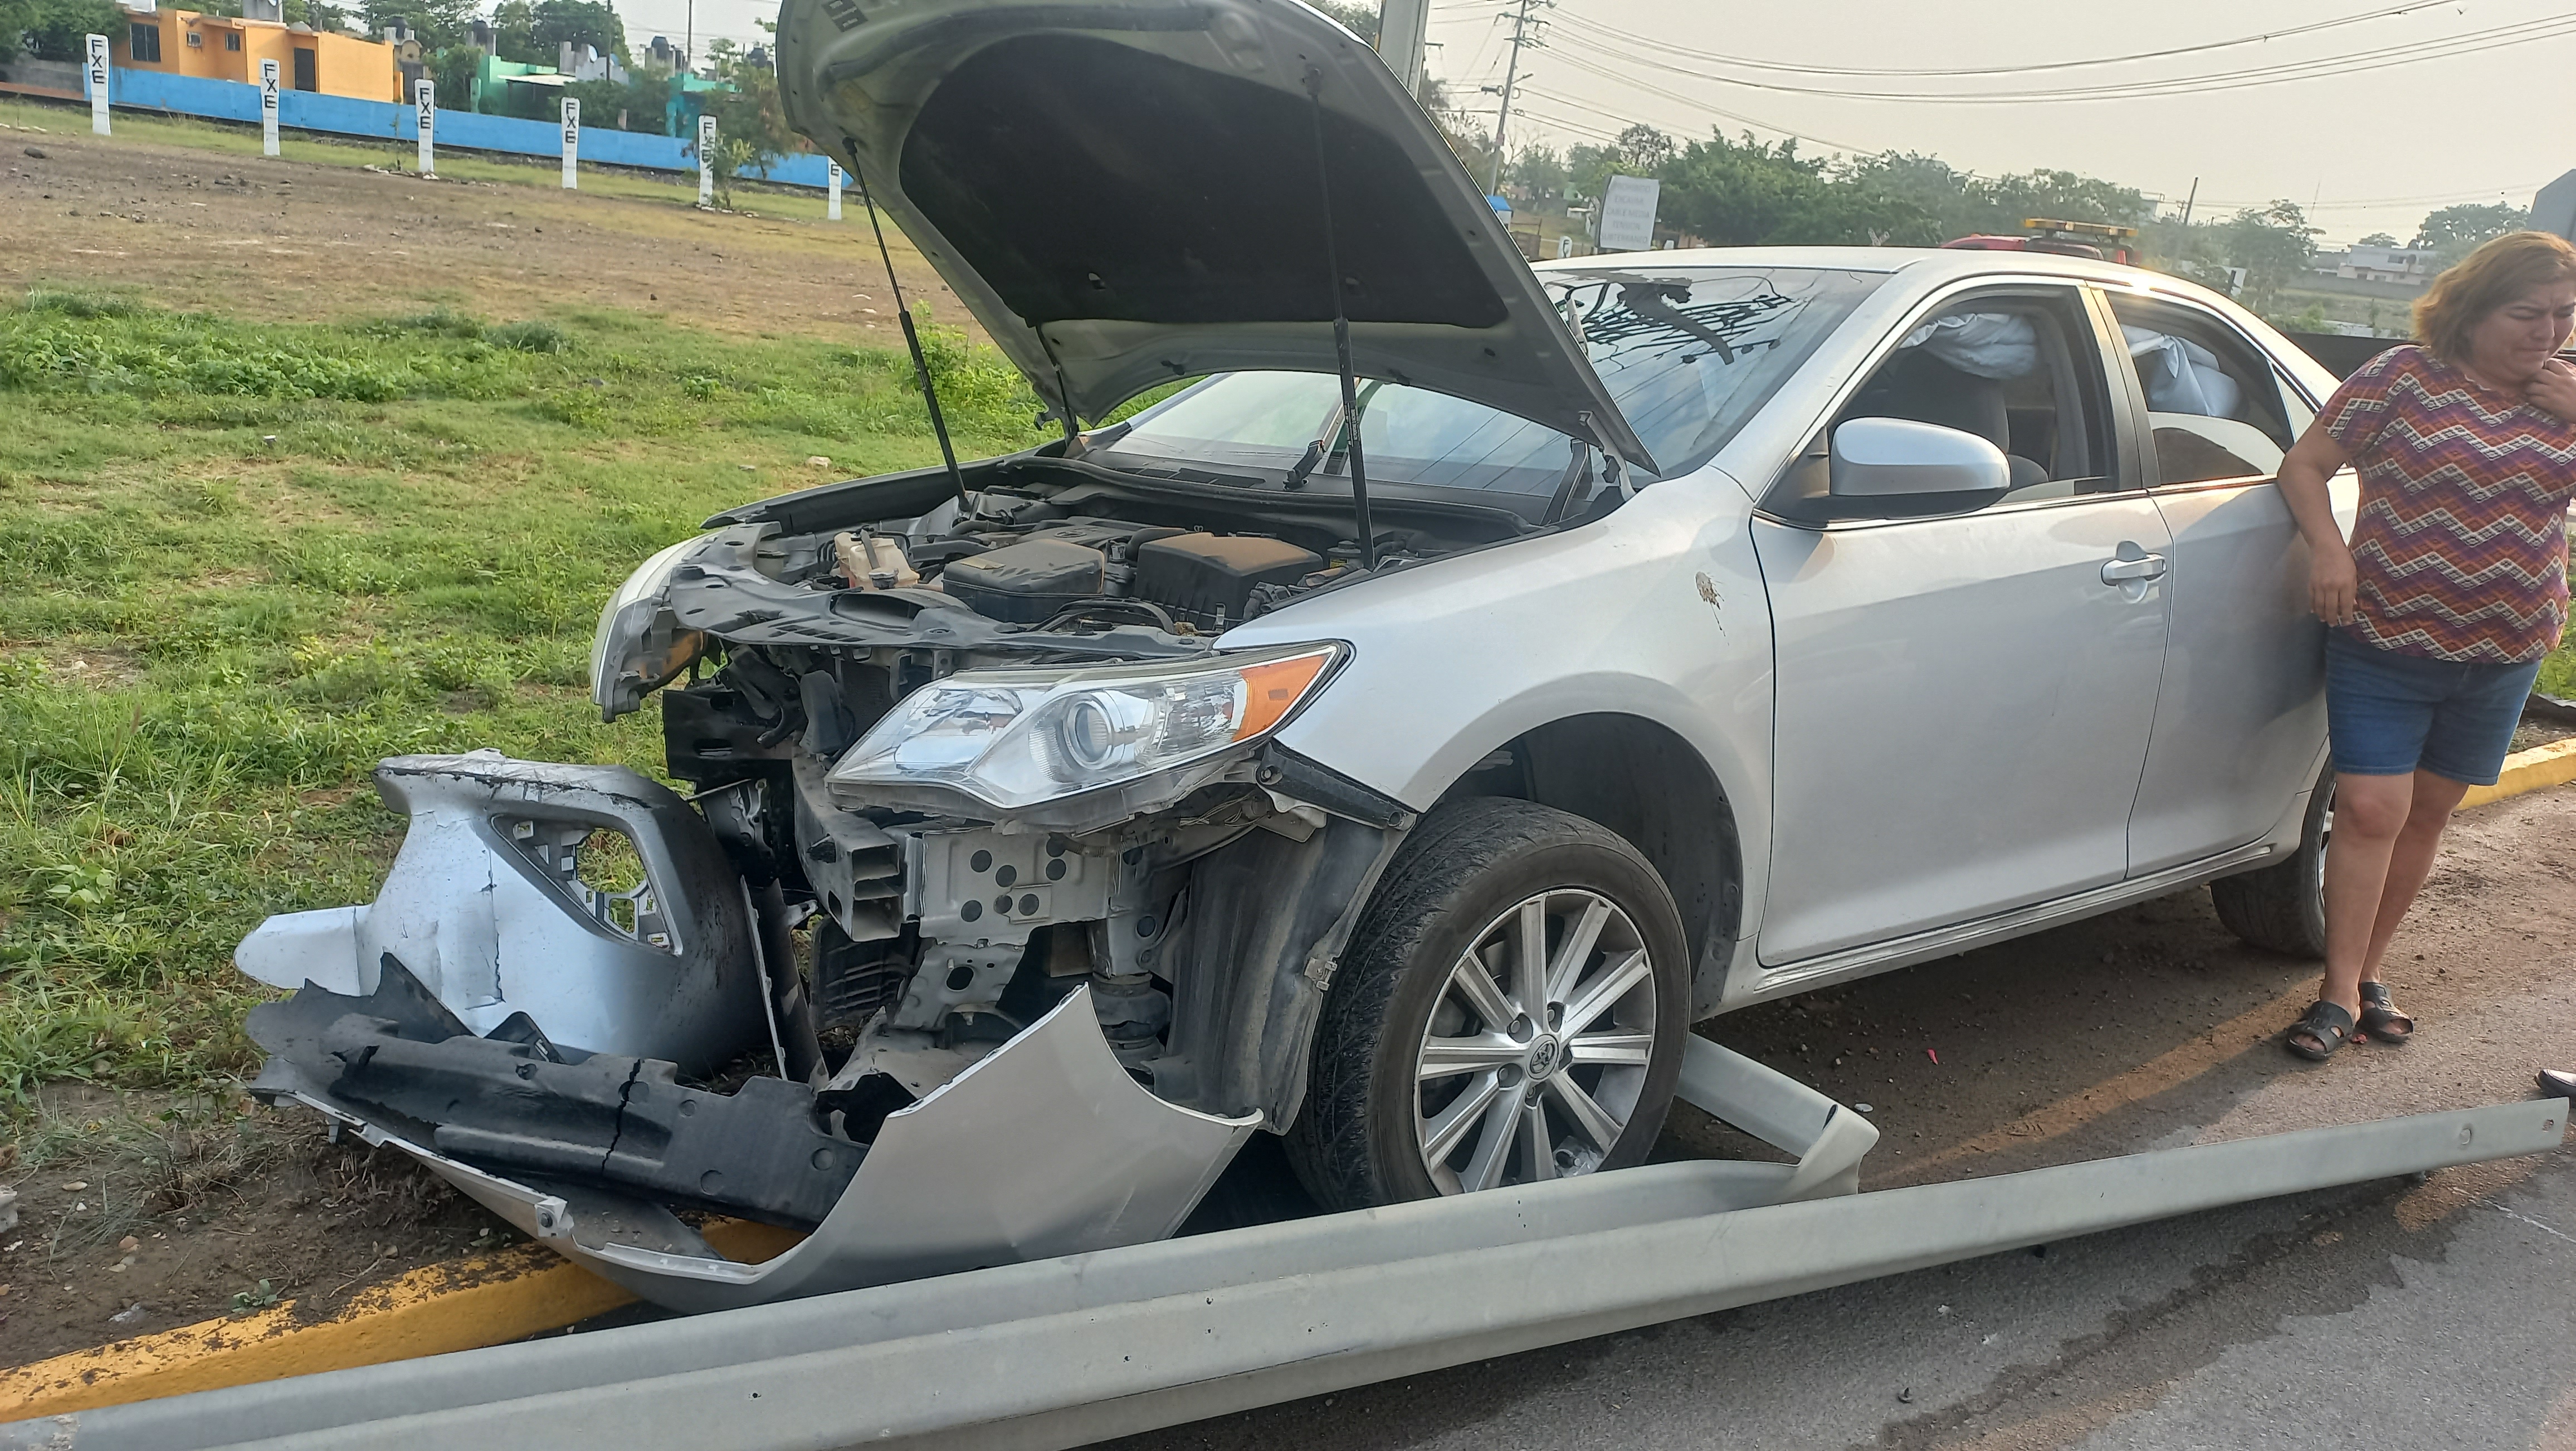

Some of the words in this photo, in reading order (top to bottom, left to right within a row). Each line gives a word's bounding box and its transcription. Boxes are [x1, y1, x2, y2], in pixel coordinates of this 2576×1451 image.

[91, 39, 105, 84] FXE
[264, 64, 277, 108] FXE
[419, 87, 431, 129] FXE
[565, 102, 576, 144] FXE
